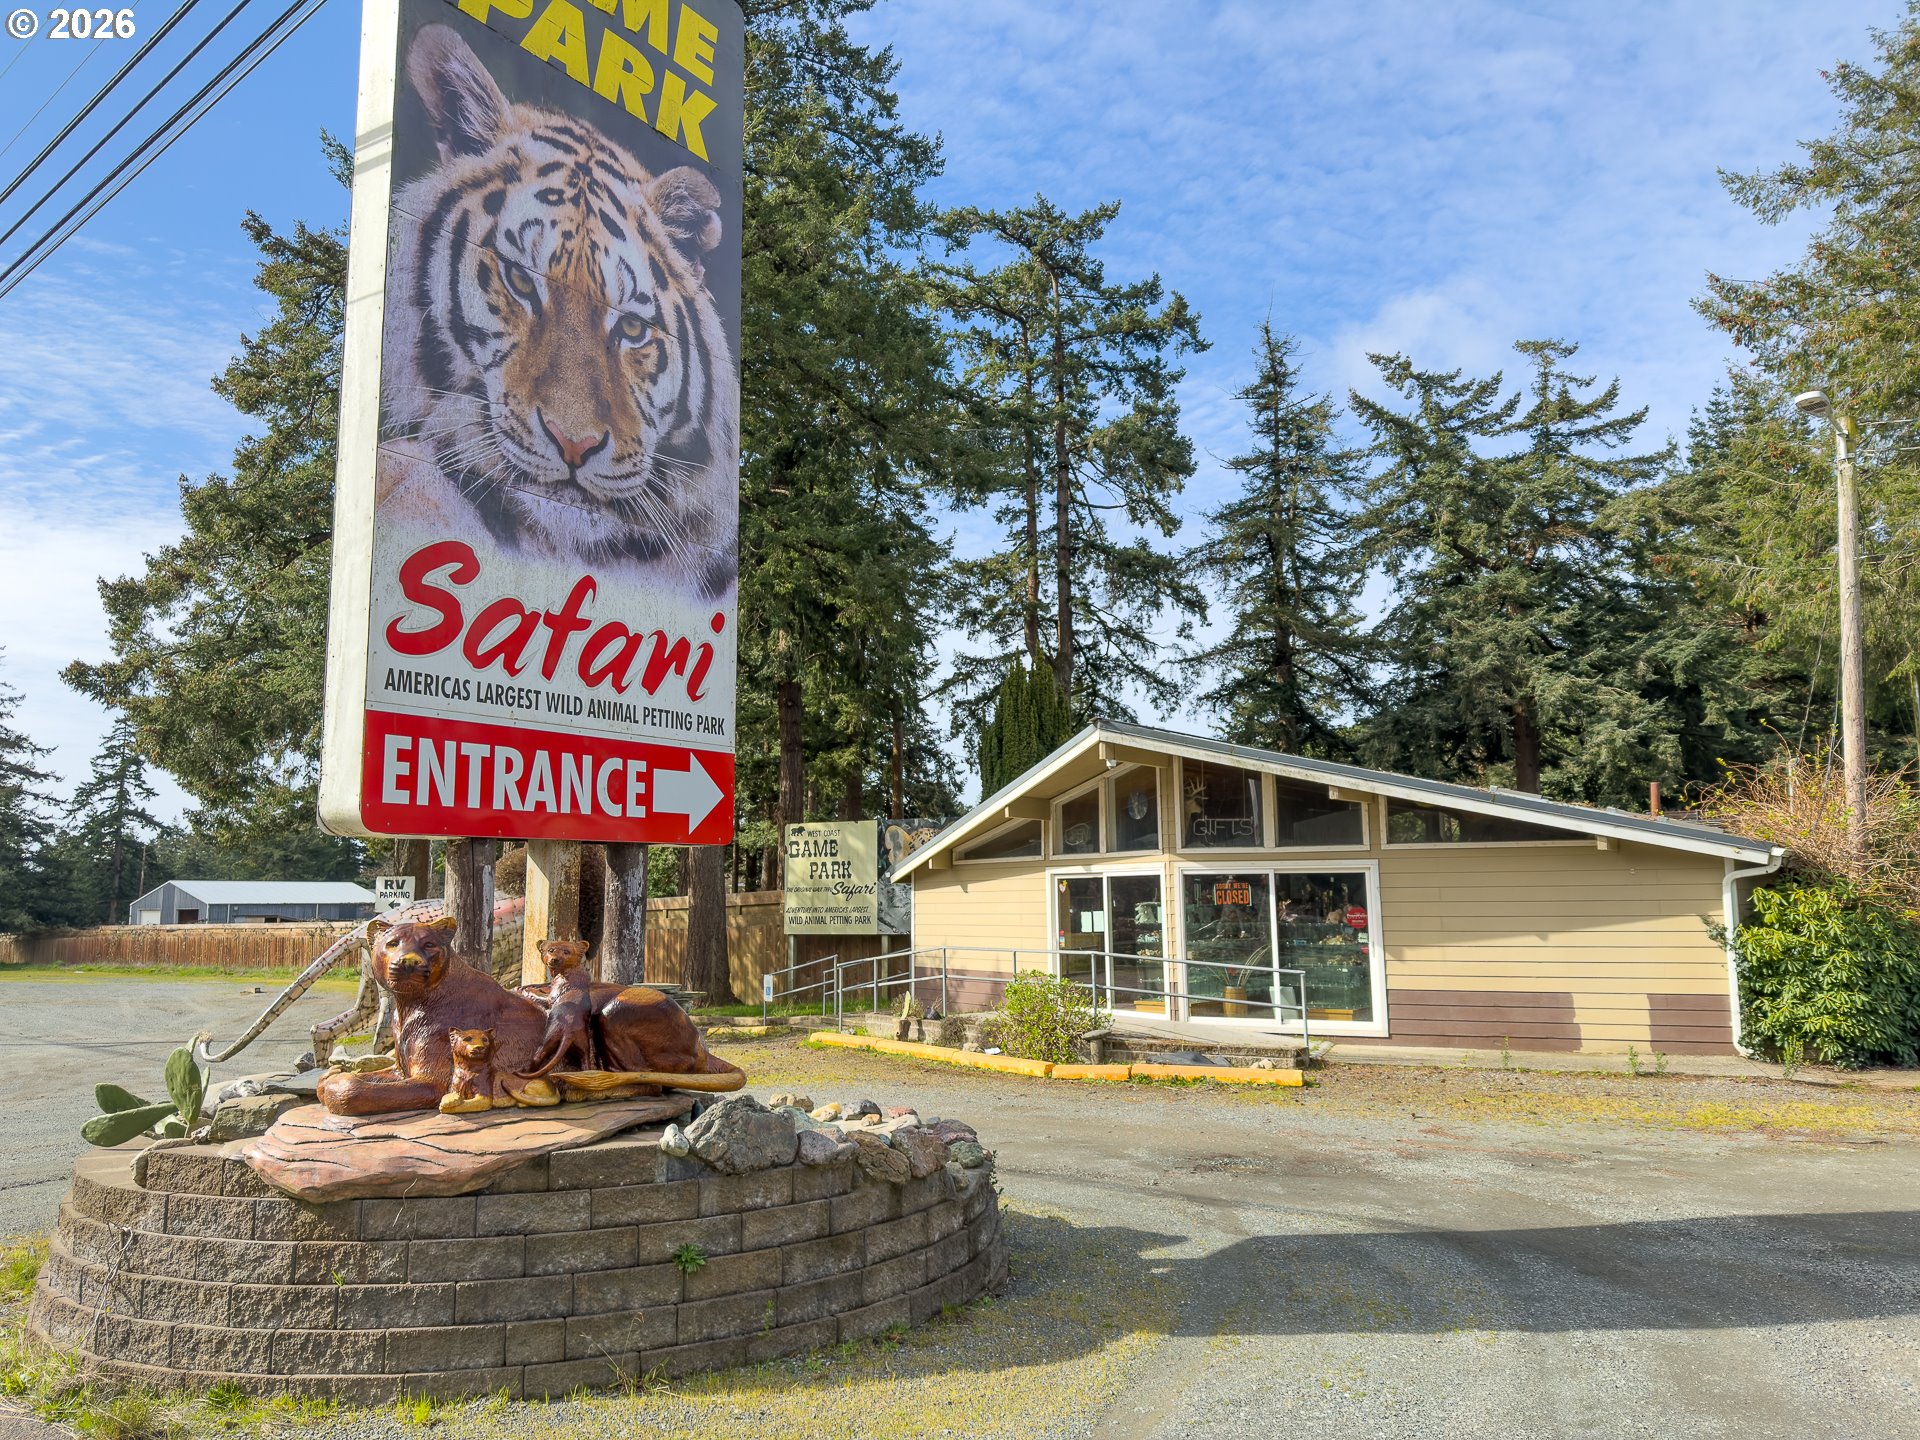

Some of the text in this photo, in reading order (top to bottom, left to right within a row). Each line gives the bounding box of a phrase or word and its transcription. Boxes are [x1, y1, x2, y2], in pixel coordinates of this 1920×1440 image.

[386, 540, 726, 702] Safari
[384, 667, 725, 736] AMERICAS LARGEST WILD ANIMAL PETTING PARK
[382, 734, 647, 819] ENTRANCE
[807, 829, 841, 838] WEST COAST
[1193, 818, 1254, 835] GIFTS
[788, 839, 839, 858] GAME
[809, 860, 852, 879] PARK
[384, 879, 407, 890] RV
[832, 881, 877, 901] Safari
[379, 891, 411, 899] PARKING
[1216, 889, 1250, 905] CLOSED
[788, 915, 872, 925] WILD ANIMAL PETTING PARK
